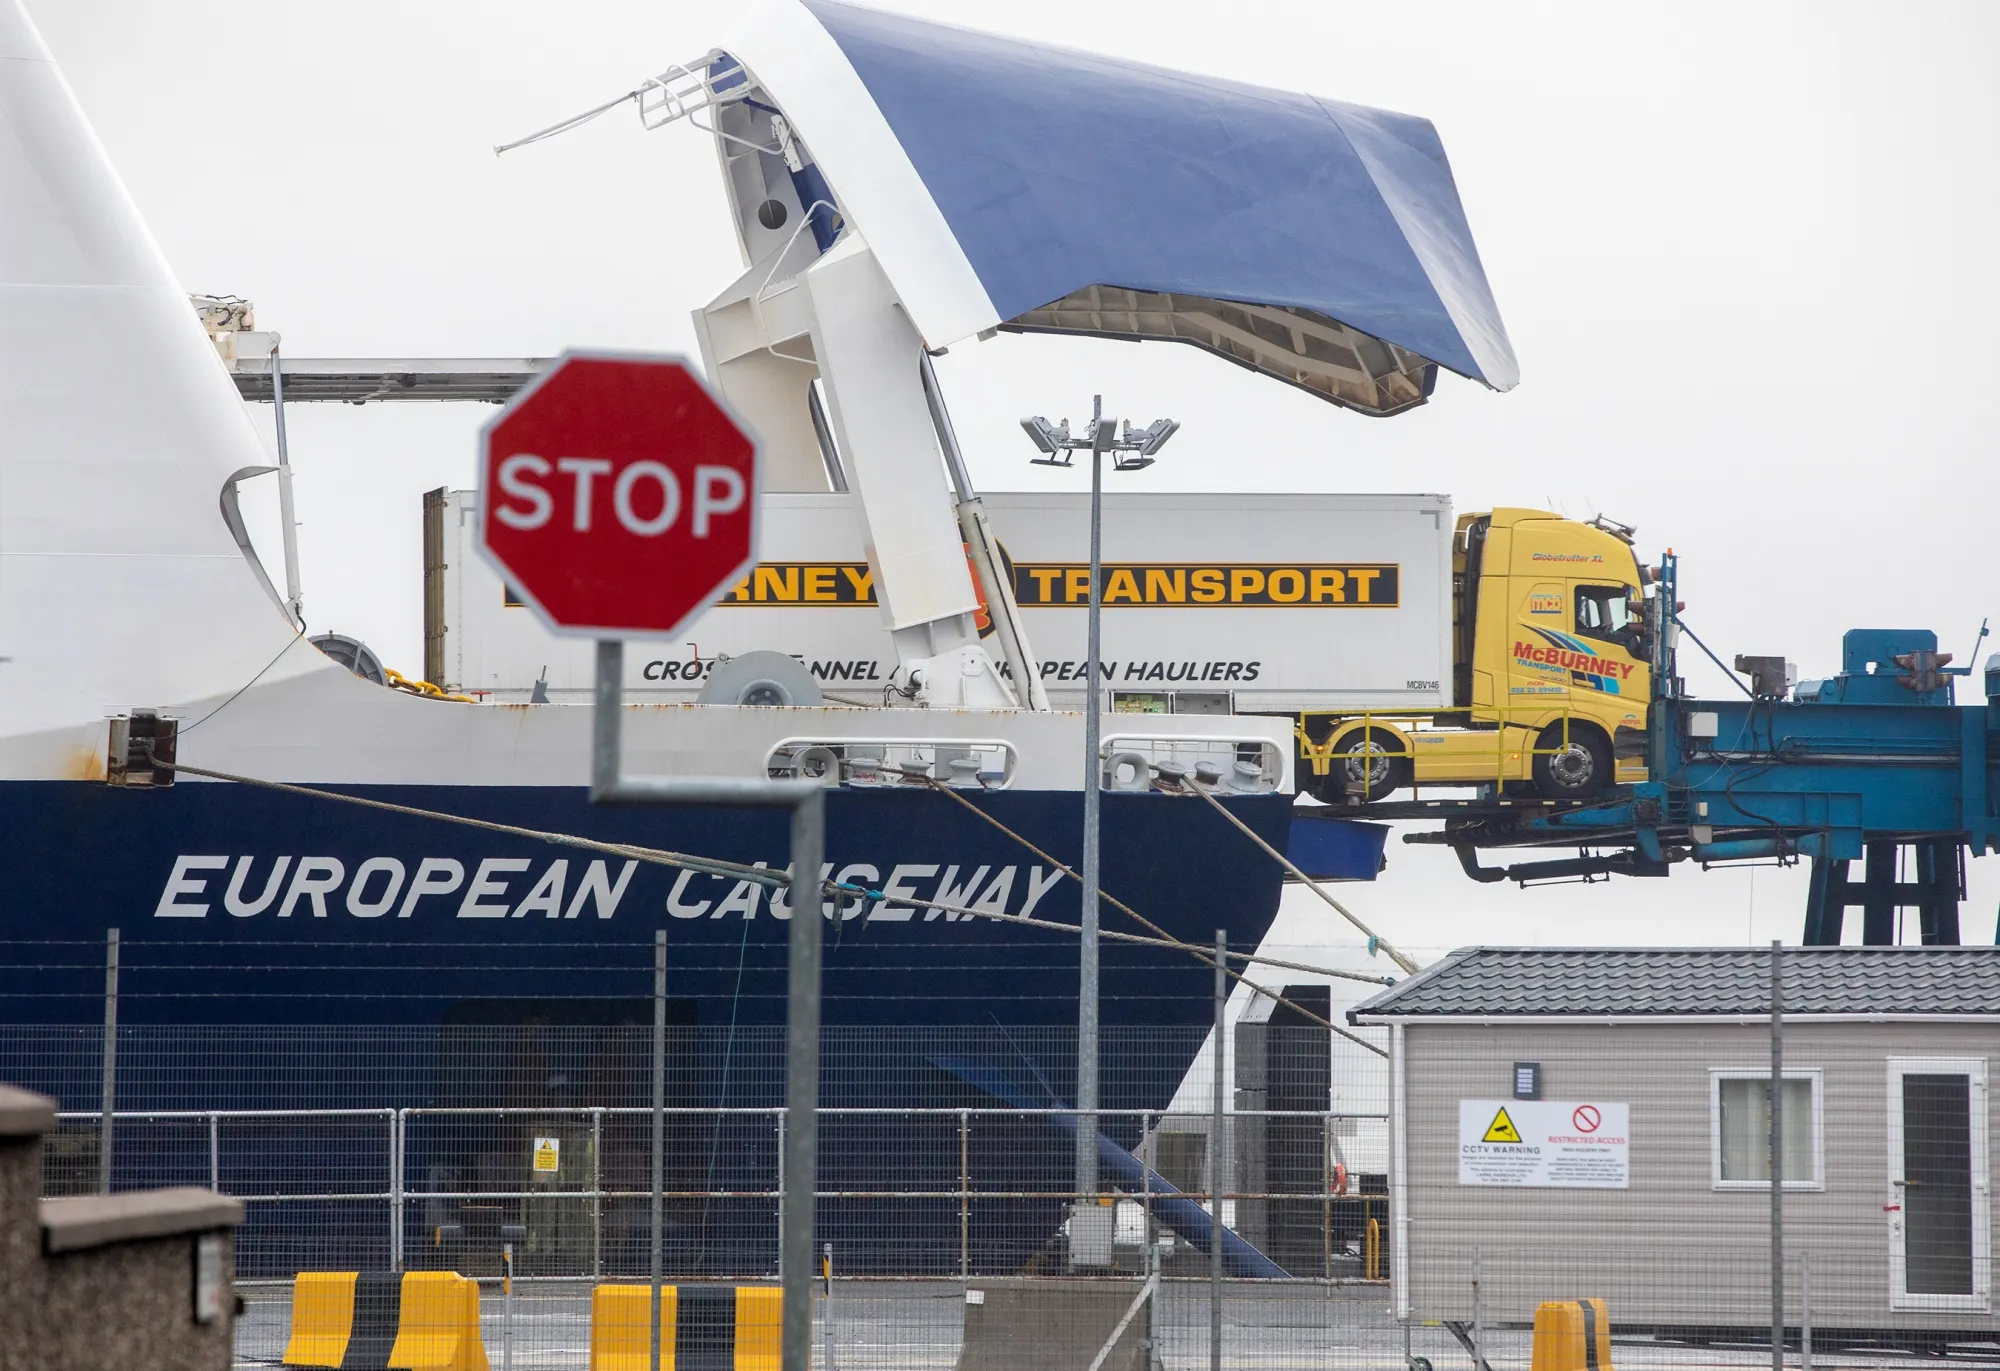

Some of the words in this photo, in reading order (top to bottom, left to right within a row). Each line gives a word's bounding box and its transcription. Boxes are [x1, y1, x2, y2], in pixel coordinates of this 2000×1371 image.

[495, 455, 746, 538] STOP
[1532, 553, 1590, 563] Globetrotter
[1591, 555, 1604, 563] XL
[1030, 570, 1380, 602] TRANSPORT
[1513, 641, 1635, 680] McBURNEY
[1516, 658, 1567, 674] TRANSPORT
[1123, 661, 1261, 681] HAULIERS
[154, 855, 640, 919] EUROPEAN
[1462, 1145, 1490, 1154] CCTV
[1492, 1146, 1541, 1155] WARNING
[1548, 1136, 1595, 1144] RESTRICTED
[1596, 1137, 1626, 1145] ACCESS
